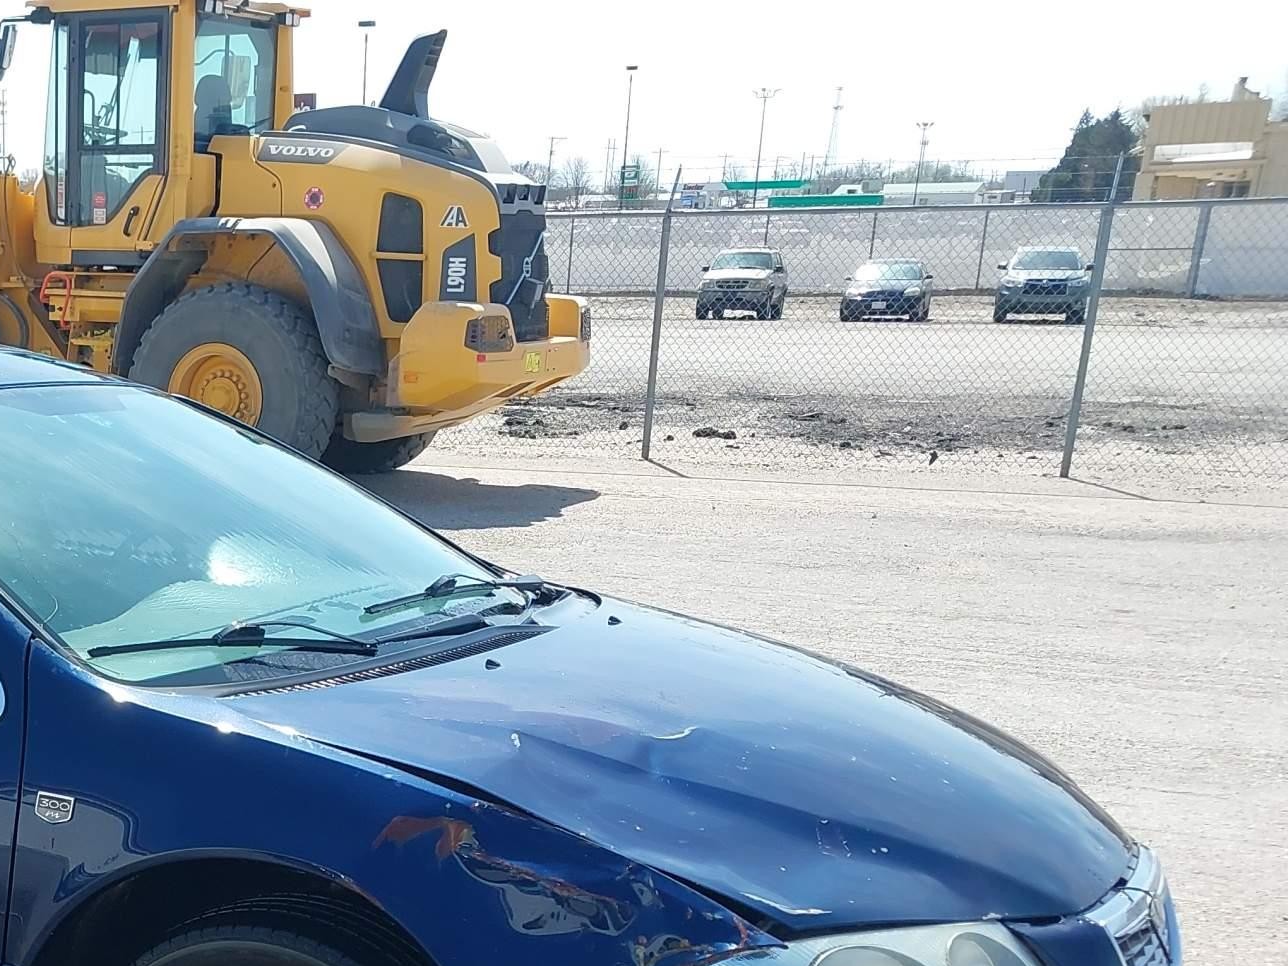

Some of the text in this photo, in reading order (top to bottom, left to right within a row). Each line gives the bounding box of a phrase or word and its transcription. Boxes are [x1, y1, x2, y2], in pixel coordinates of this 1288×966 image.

[268, 145, 335, 157] VOLVO
[446, 257, 467, 293] L90H
[39, 797, 70, 811] 300
